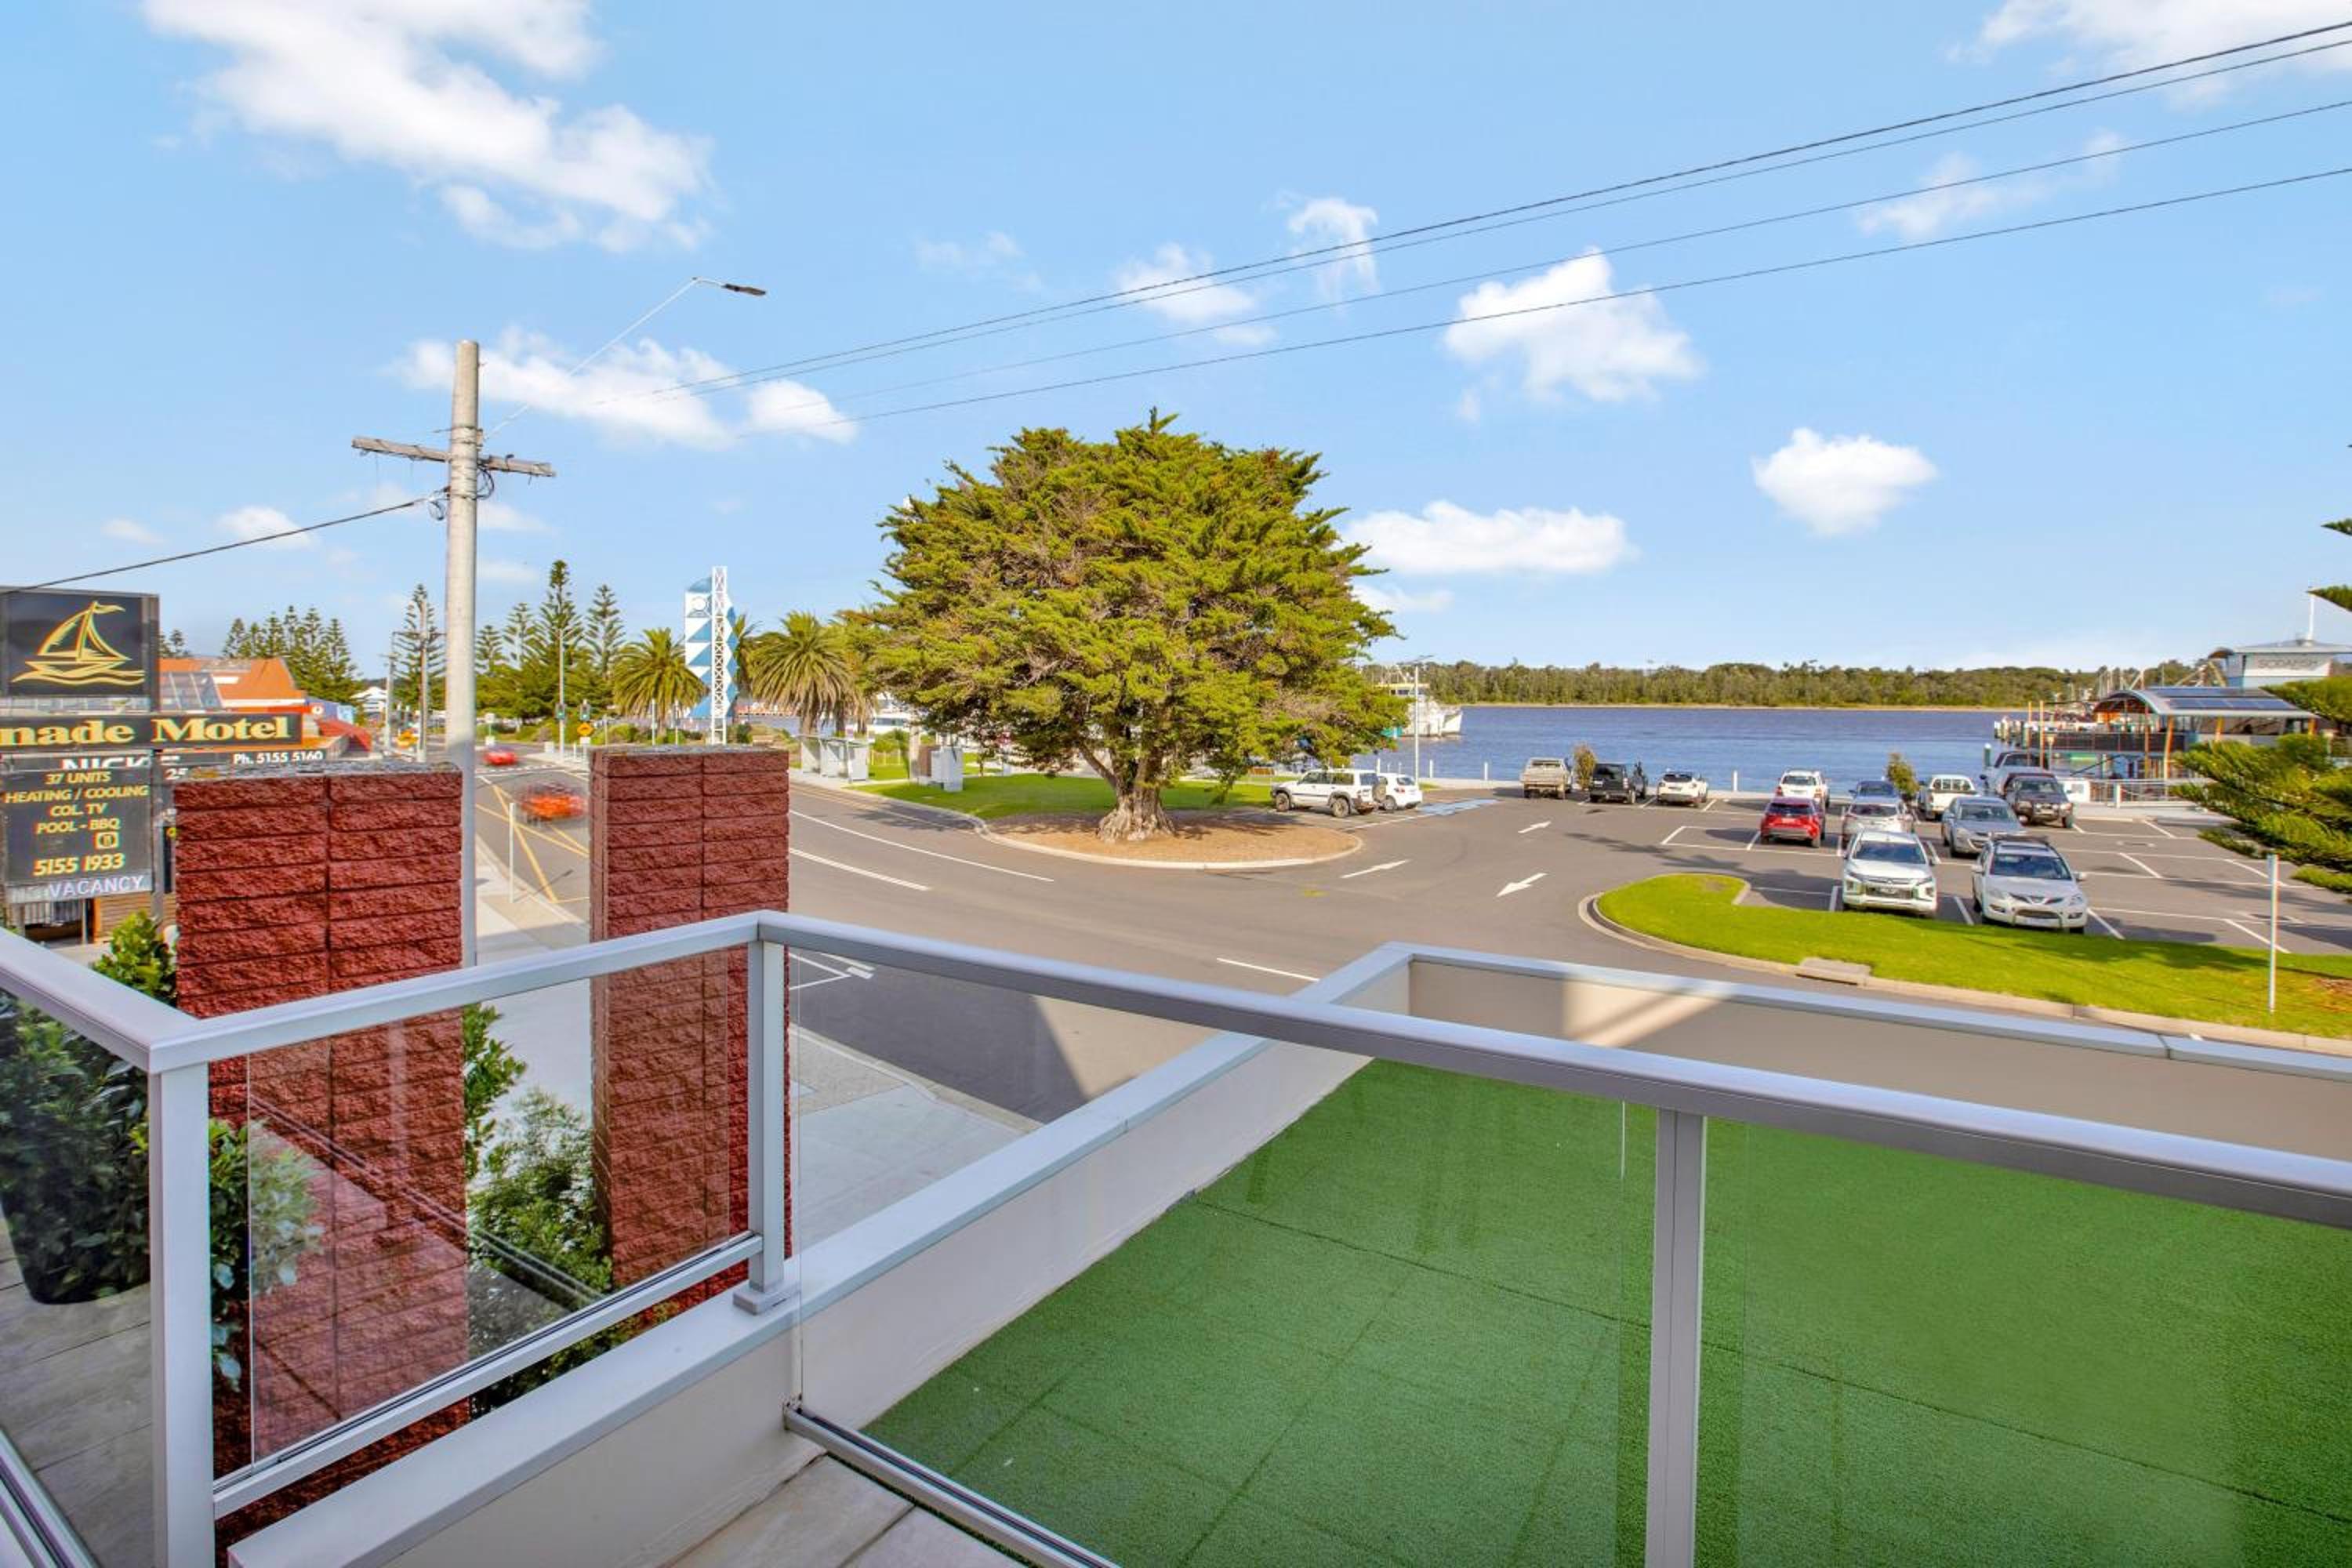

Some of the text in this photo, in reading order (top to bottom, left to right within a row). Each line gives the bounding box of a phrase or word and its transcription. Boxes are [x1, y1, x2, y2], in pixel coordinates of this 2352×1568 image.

[151, 716, 291, 742] Motel
[234, 750, 324, 764] Ph. 5155 5160
[45, 771, 111, 784] 37 UNITS
[5, 789, 72, 804] HEATING
[84, 785, 150, 799] COOLING
[85, 802, 108, 815] TV
[36, 820, 78, 834] POOL
[88, 818, 121, 830] BBQ
[33, 852, 125, 877] 5155 1933
[49, 875, 144, 898] VACANCY
